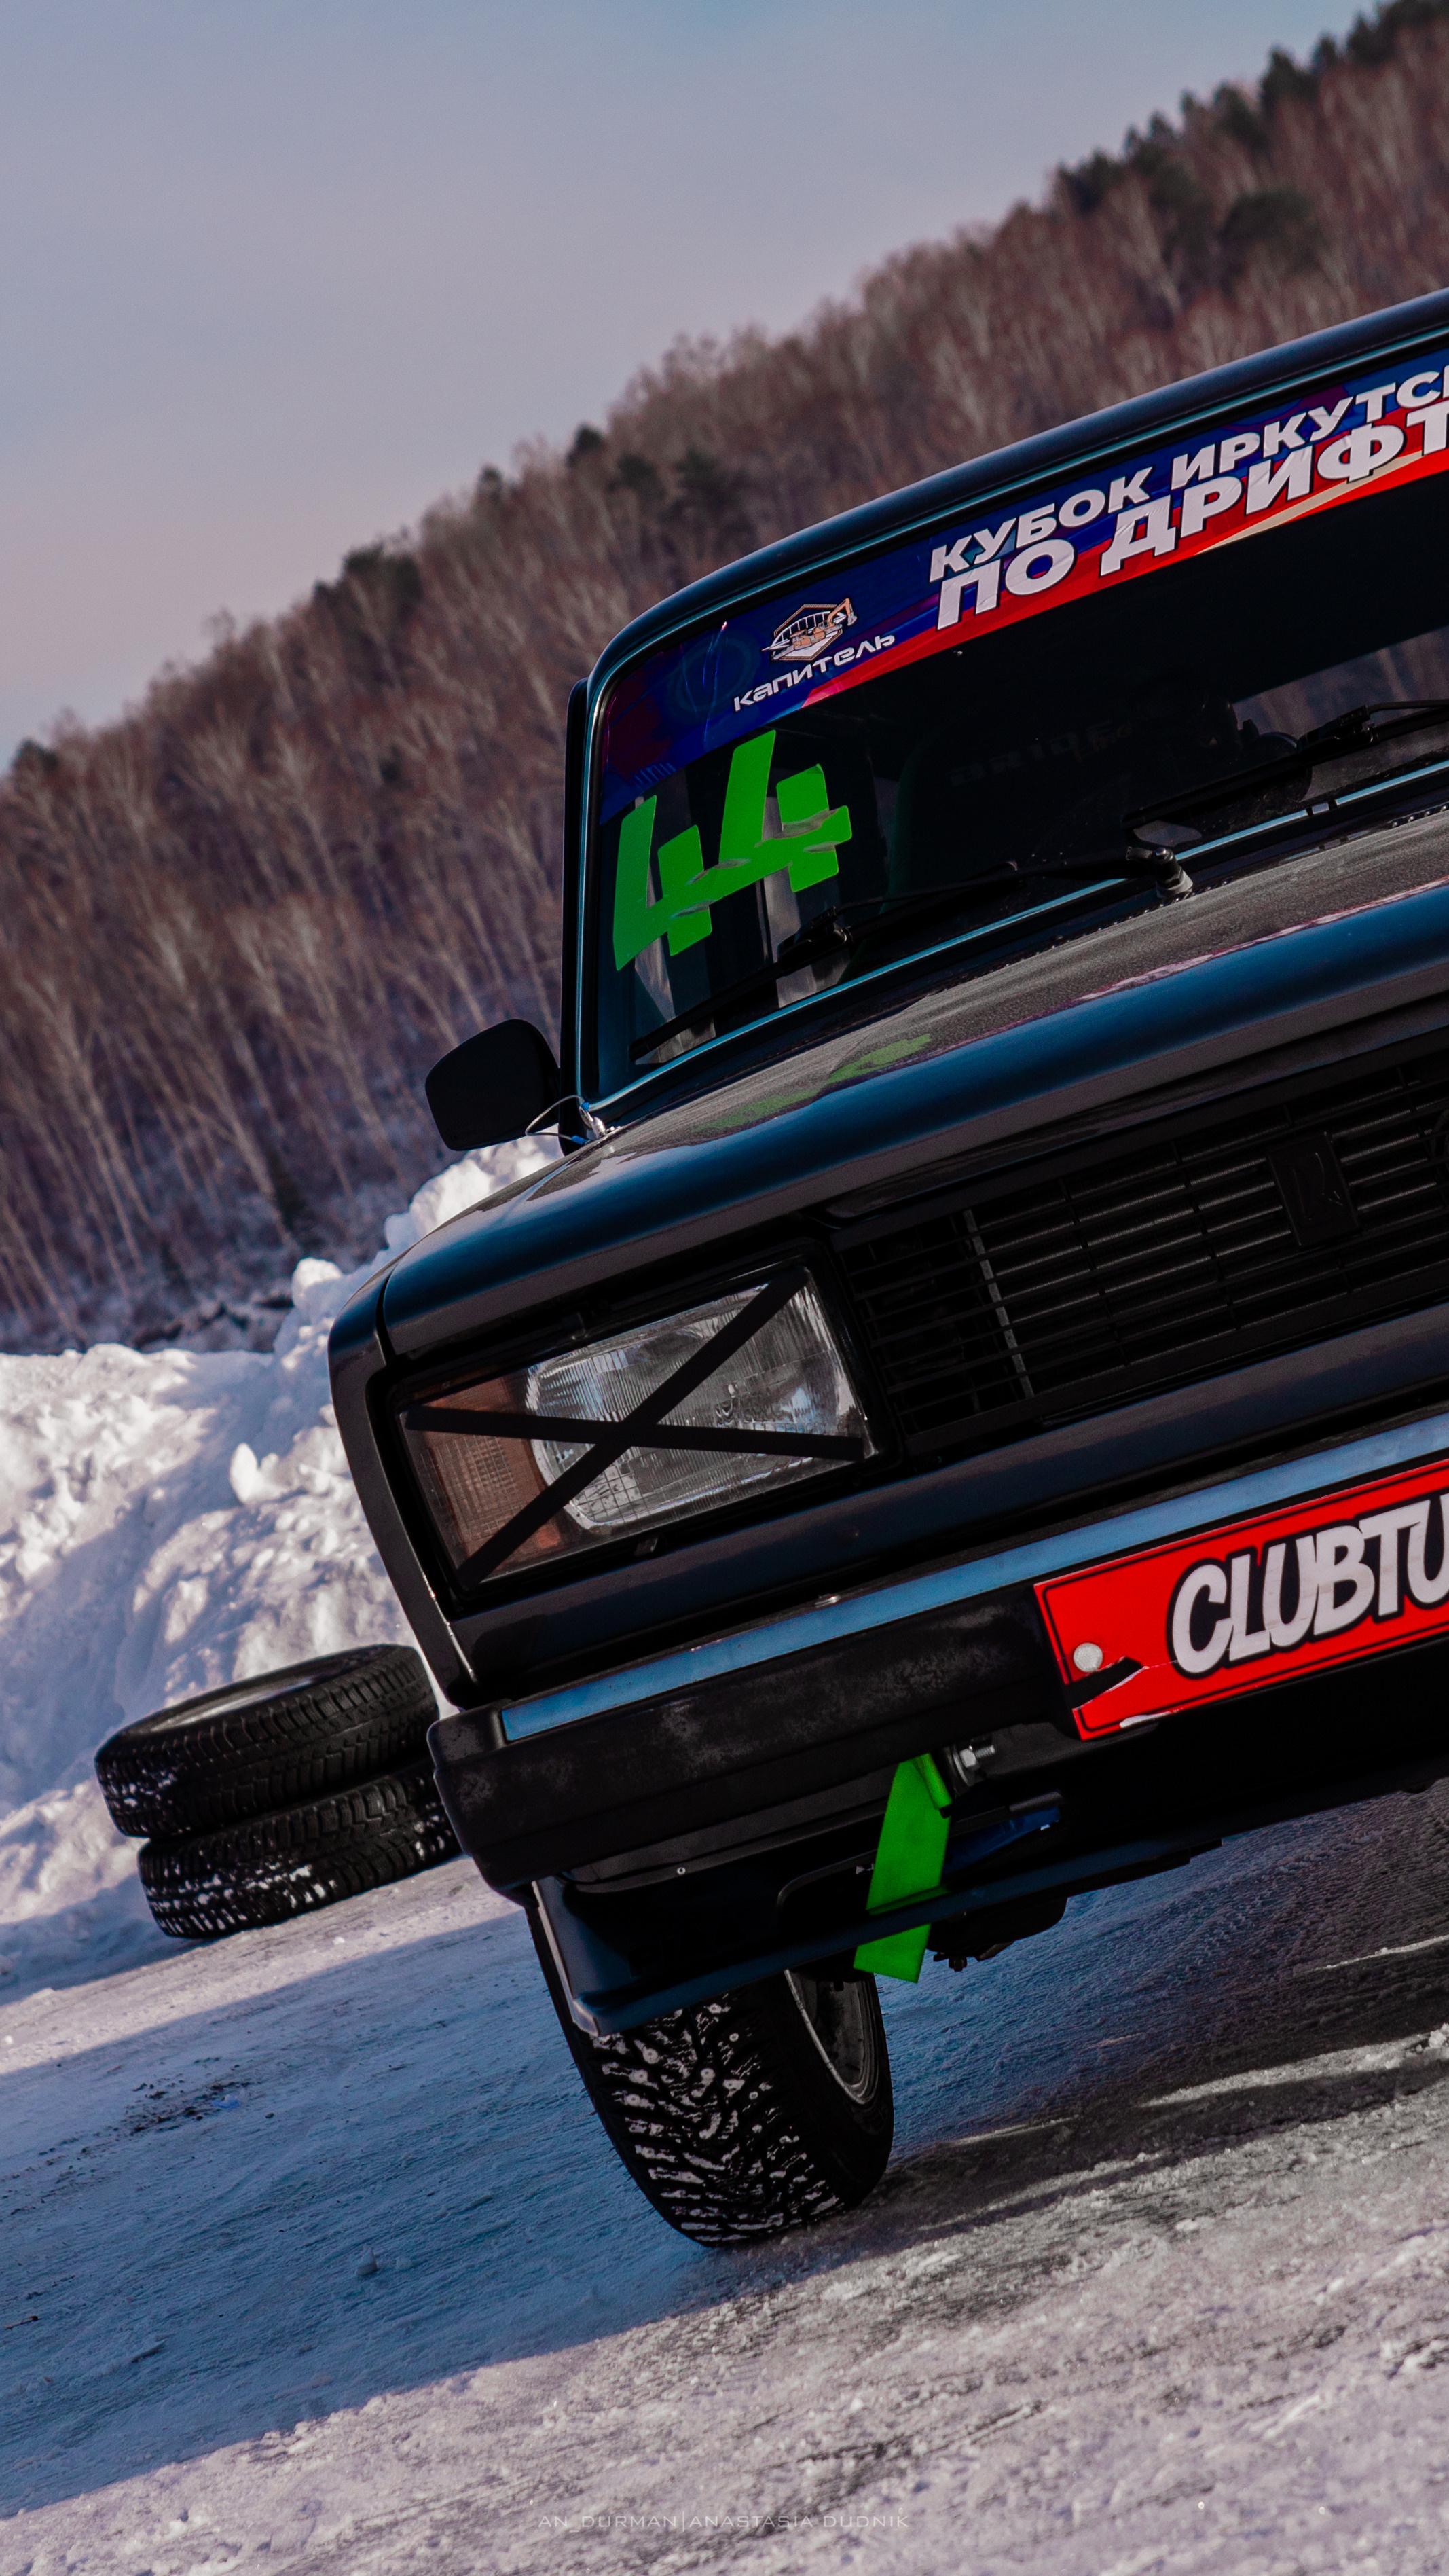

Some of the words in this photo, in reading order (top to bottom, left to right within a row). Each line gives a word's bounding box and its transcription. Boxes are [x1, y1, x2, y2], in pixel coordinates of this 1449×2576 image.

[930, 465, 1152, 582] КУБОК
[1171, 365, 1449, 490] ИРКУТС
[936, 539, 1077, 631] ПО
[1100, 399, 1449, 577] ДРИФТ
[613, 730, 852, 971] 44
[1173, 1493, 1449, 1673] CLUBTU
